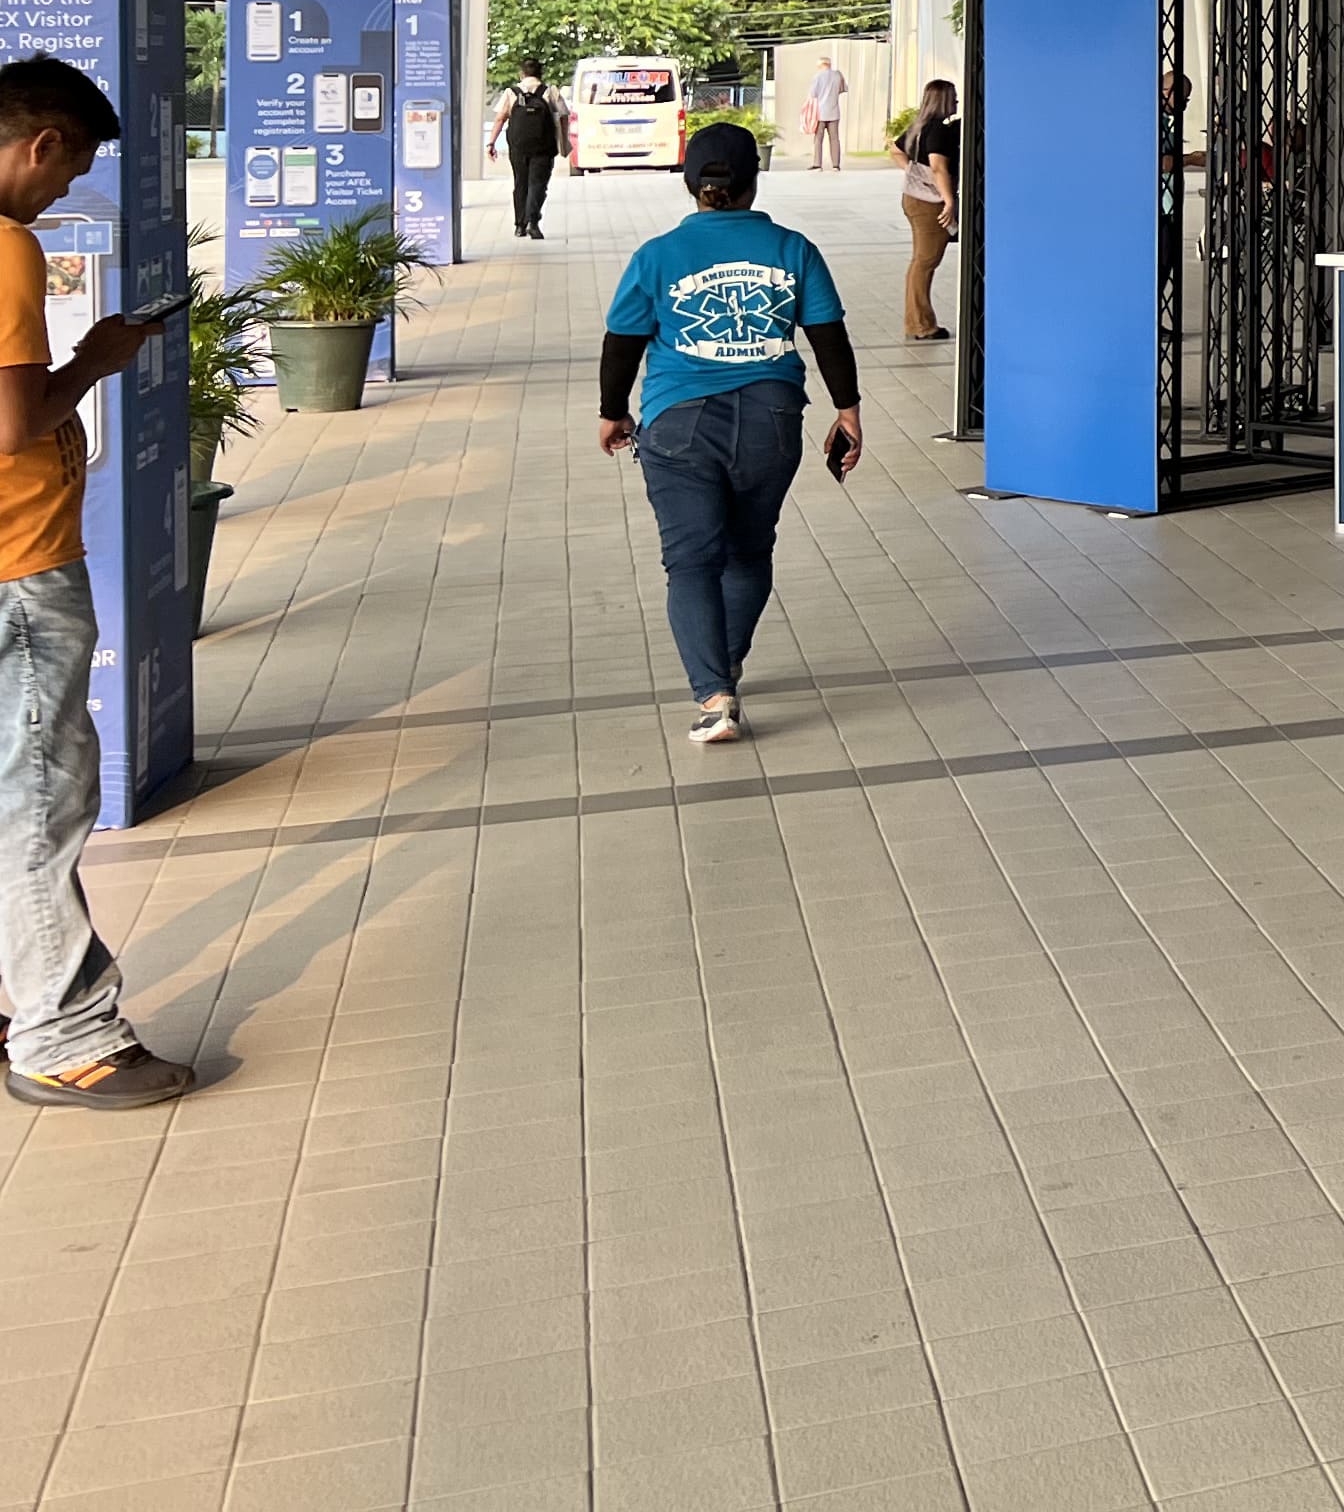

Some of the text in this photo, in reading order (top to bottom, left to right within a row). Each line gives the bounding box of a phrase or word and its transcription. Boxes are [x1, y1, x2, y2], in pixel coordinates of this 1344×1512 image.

[25, 11, 93, 27] Visitor
[289, 10, 302, 32] 1
[405, 15, 418, 36] 1
[19, 33, 104, 52] Register
[286, 73, 305, 95] 2
[256, 99, 306, 108] Verify your
[253, 127, 306, 136] registration
[325, 144, 345, 166] 3
[325, 170, 366, 178] Purchase
[347, 178, 372, 186] AFEX
[356, 188, 383, 196] Ticket
[404, 190, 424, 213] 3
[702, 268, 764, 284] AMBUCORE
[714, 345, 767, 358] ADMIN
